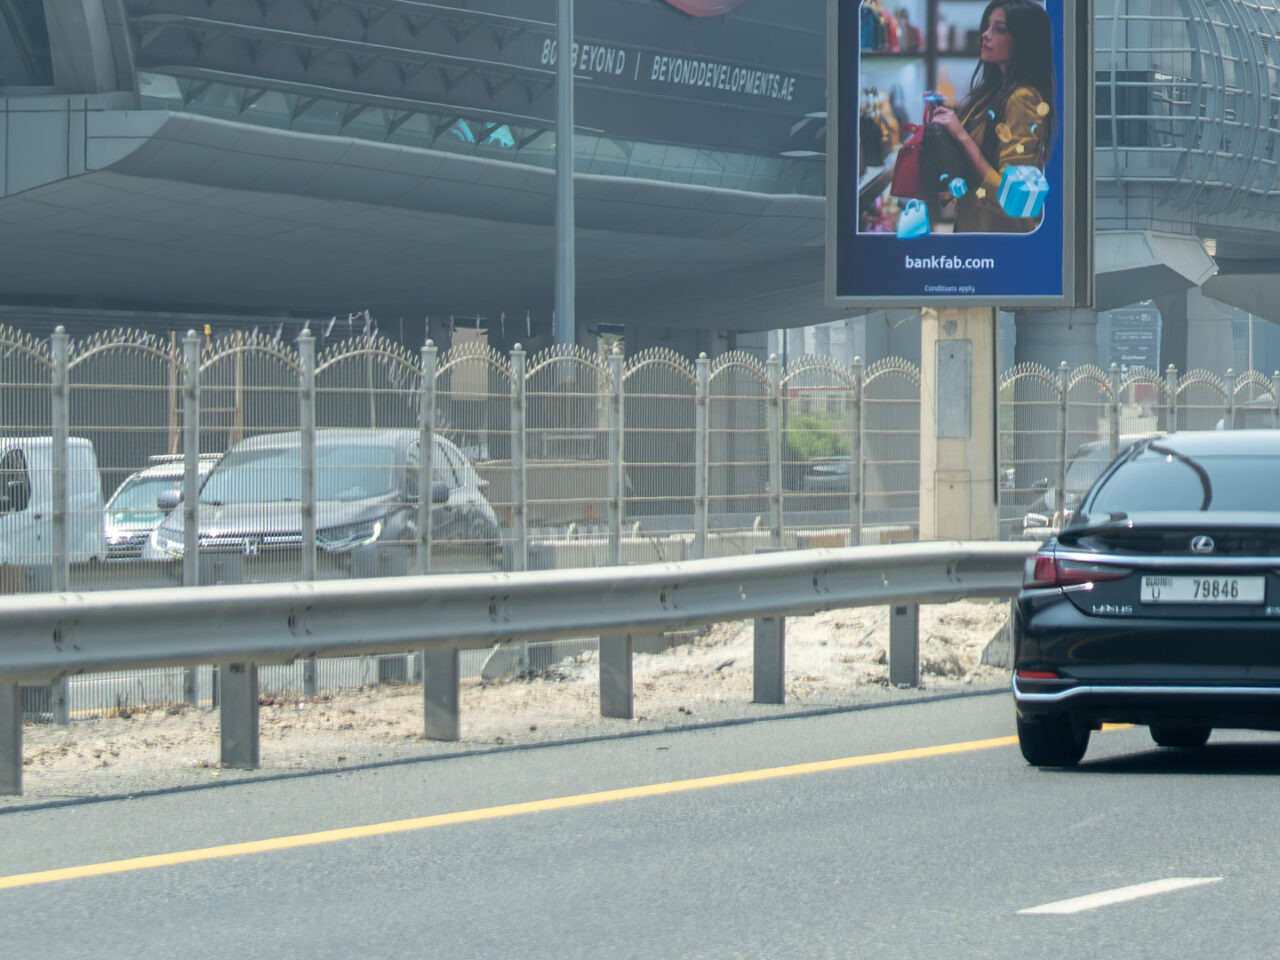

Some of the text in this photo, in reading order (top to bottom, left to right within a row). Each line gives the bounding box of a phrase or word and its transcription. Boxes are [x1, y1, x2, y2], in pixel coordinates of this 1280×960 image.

[651, 55, 796, 101] BEYONDDEVELOPMENTS.AE
[905, 255, 995, 269] bankfab.com
[924, 284, 976, 293] Conditions apply
[1193, 579, 1239, 598] 79846
